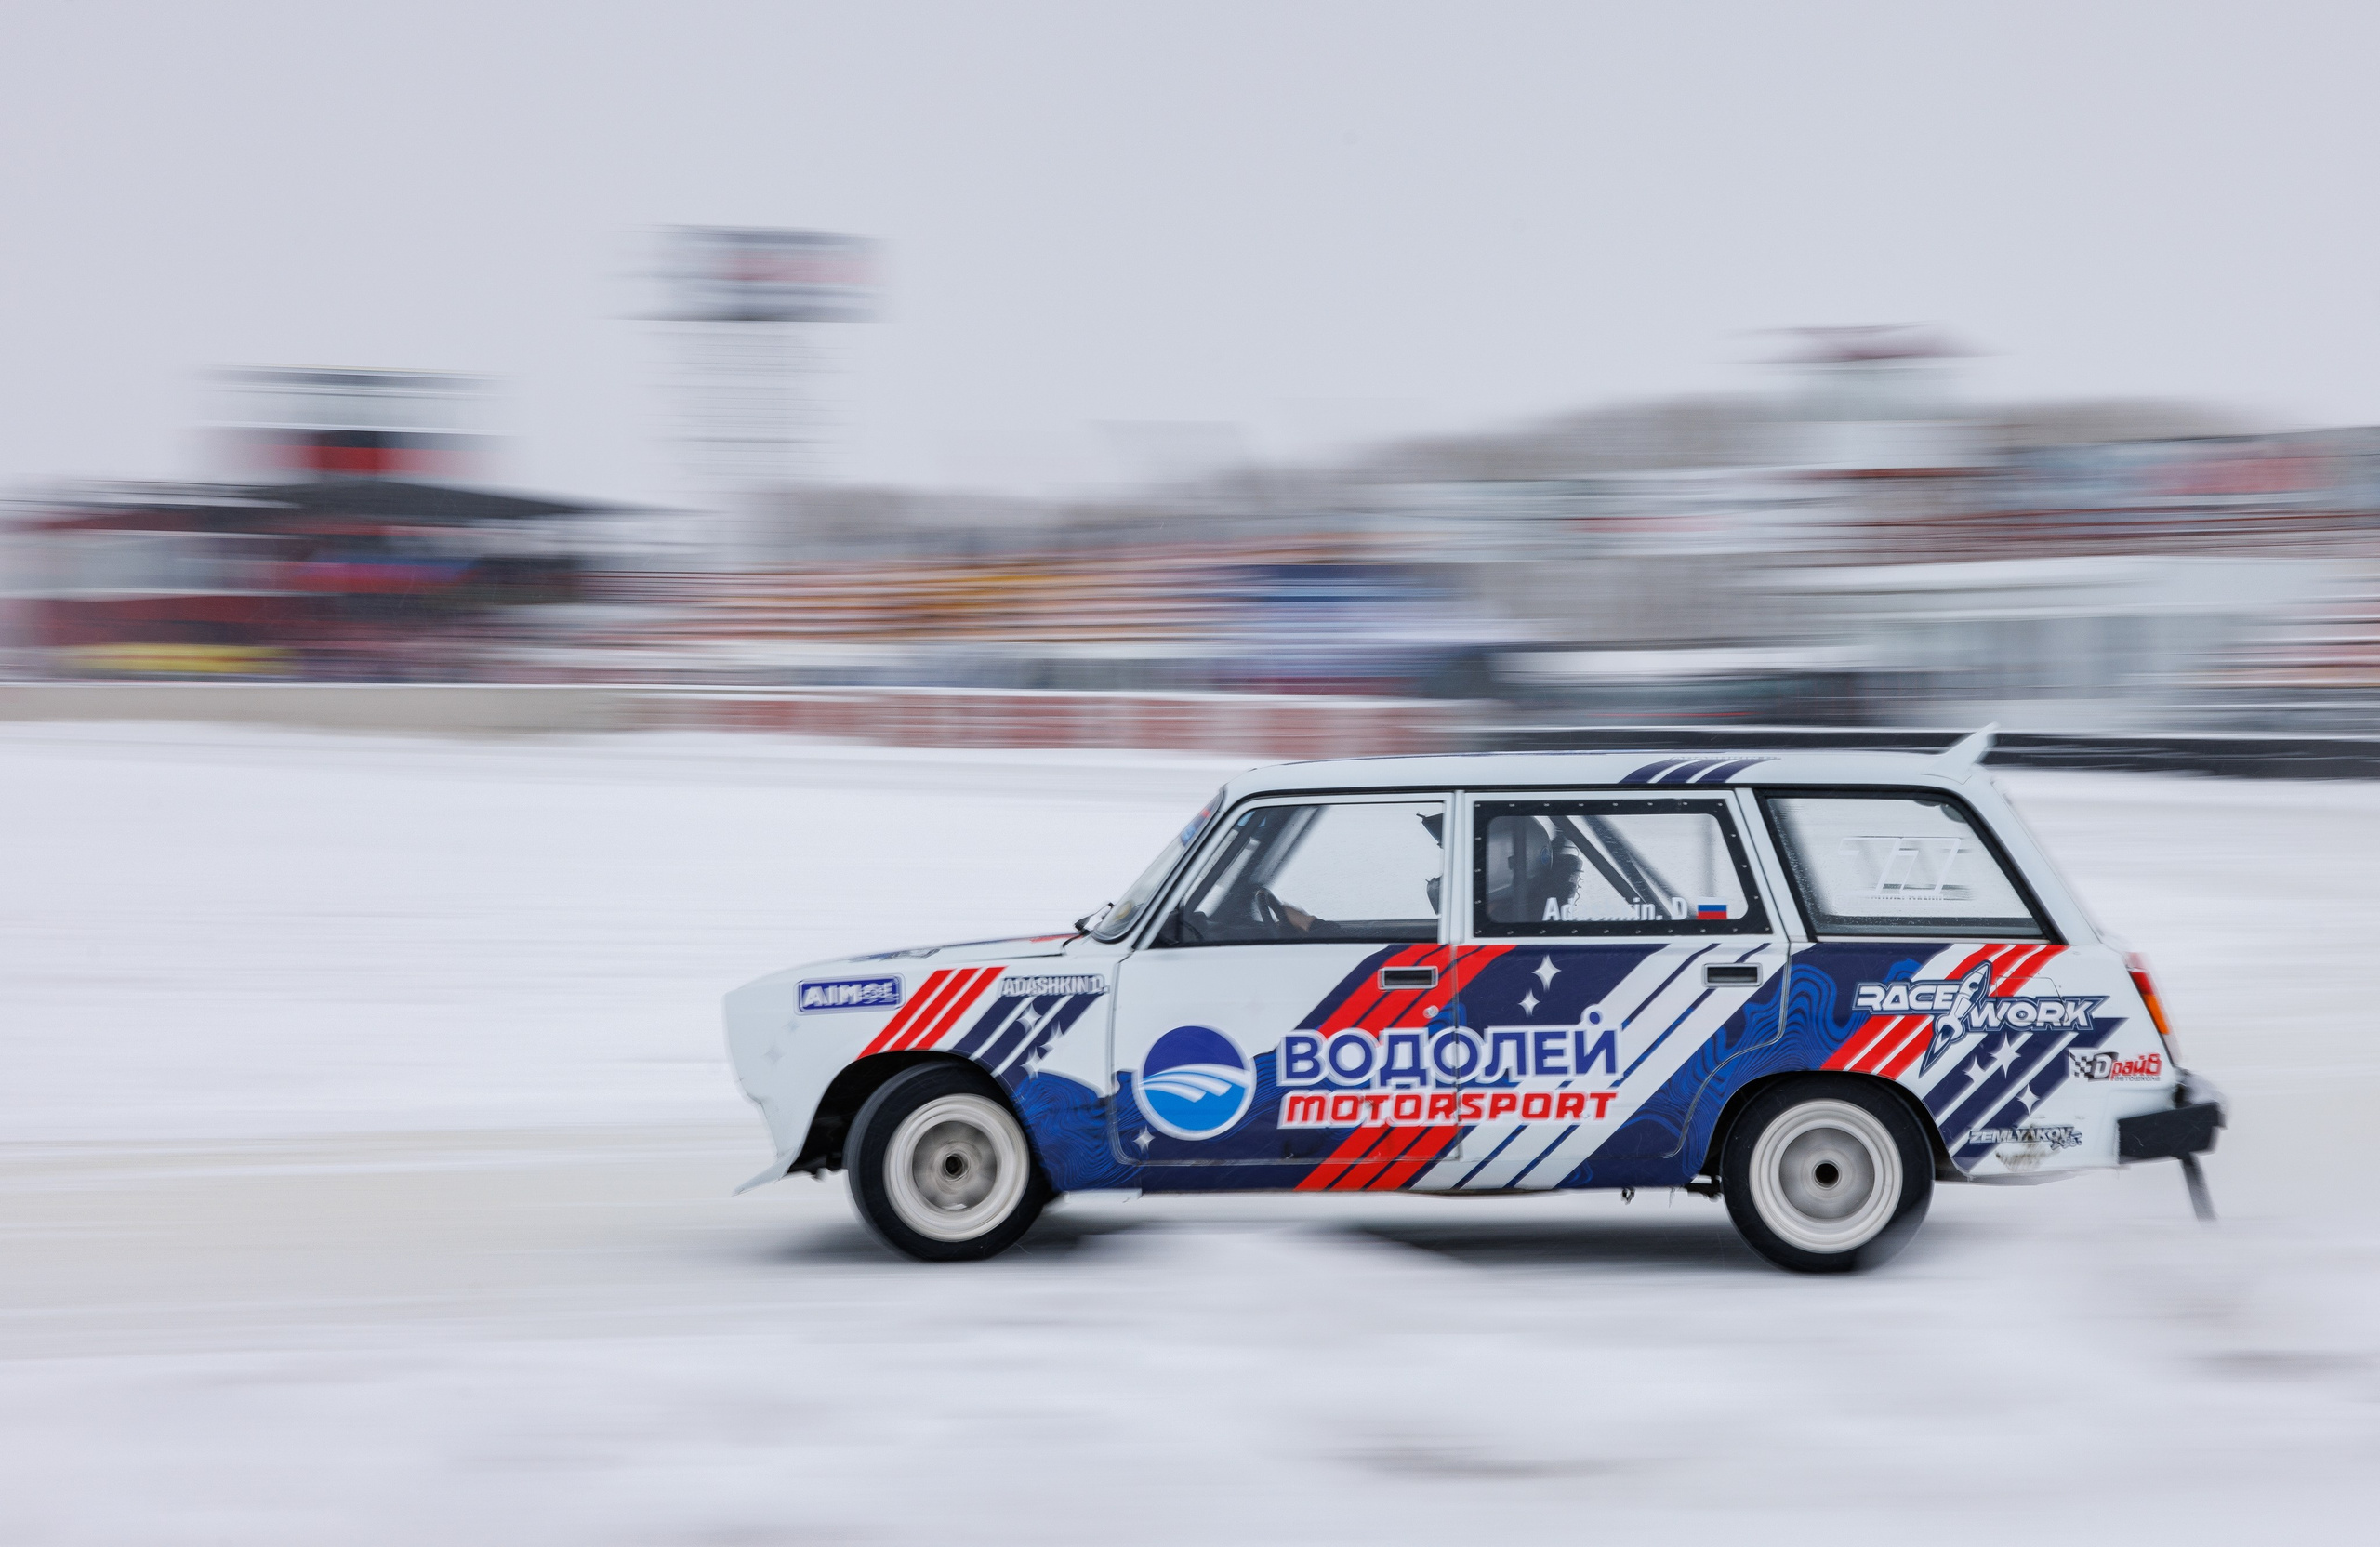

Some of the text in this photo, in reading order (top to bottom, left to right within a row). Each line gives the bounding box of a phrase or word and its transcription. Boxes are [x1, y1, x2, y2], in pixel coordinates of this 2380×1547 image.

[1671, 896, 1688, 920] D
[1857, 983, 1958, 1012] RACE
[1970, 999, 2092, 1028] WORK
[1284, 1011, 1619, 1088] ВОДОЛЕЙ
[1283, 1091, 1619, 1123] MOTORSPORT
